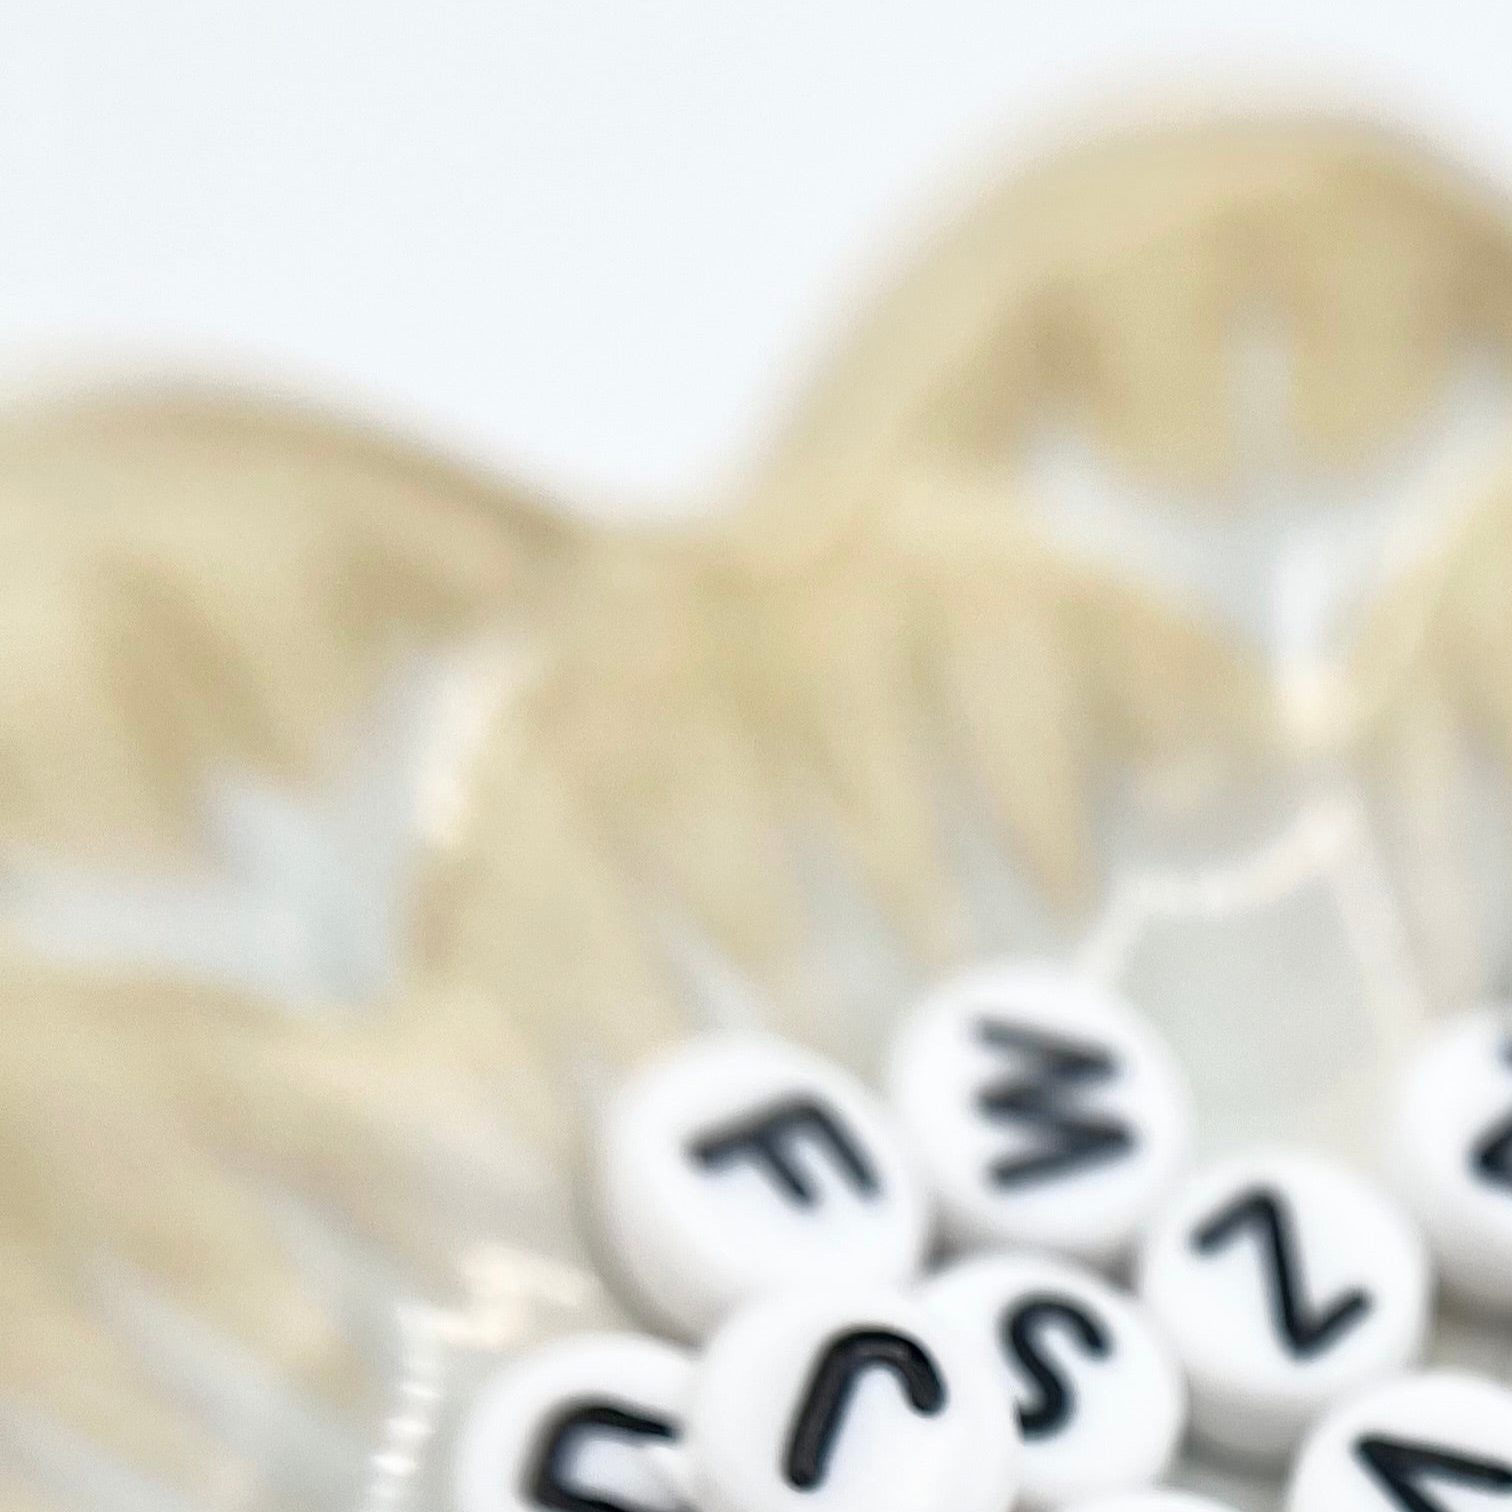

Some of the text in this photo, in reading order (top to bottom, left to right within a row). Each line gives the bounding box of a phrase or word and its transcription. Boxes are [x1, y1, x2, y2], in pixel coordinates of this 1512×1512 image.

[688, 1090, 880, 1208] F
[783, 1327, 945, 1491] J
[998, 1292, 1114, 1438] S
